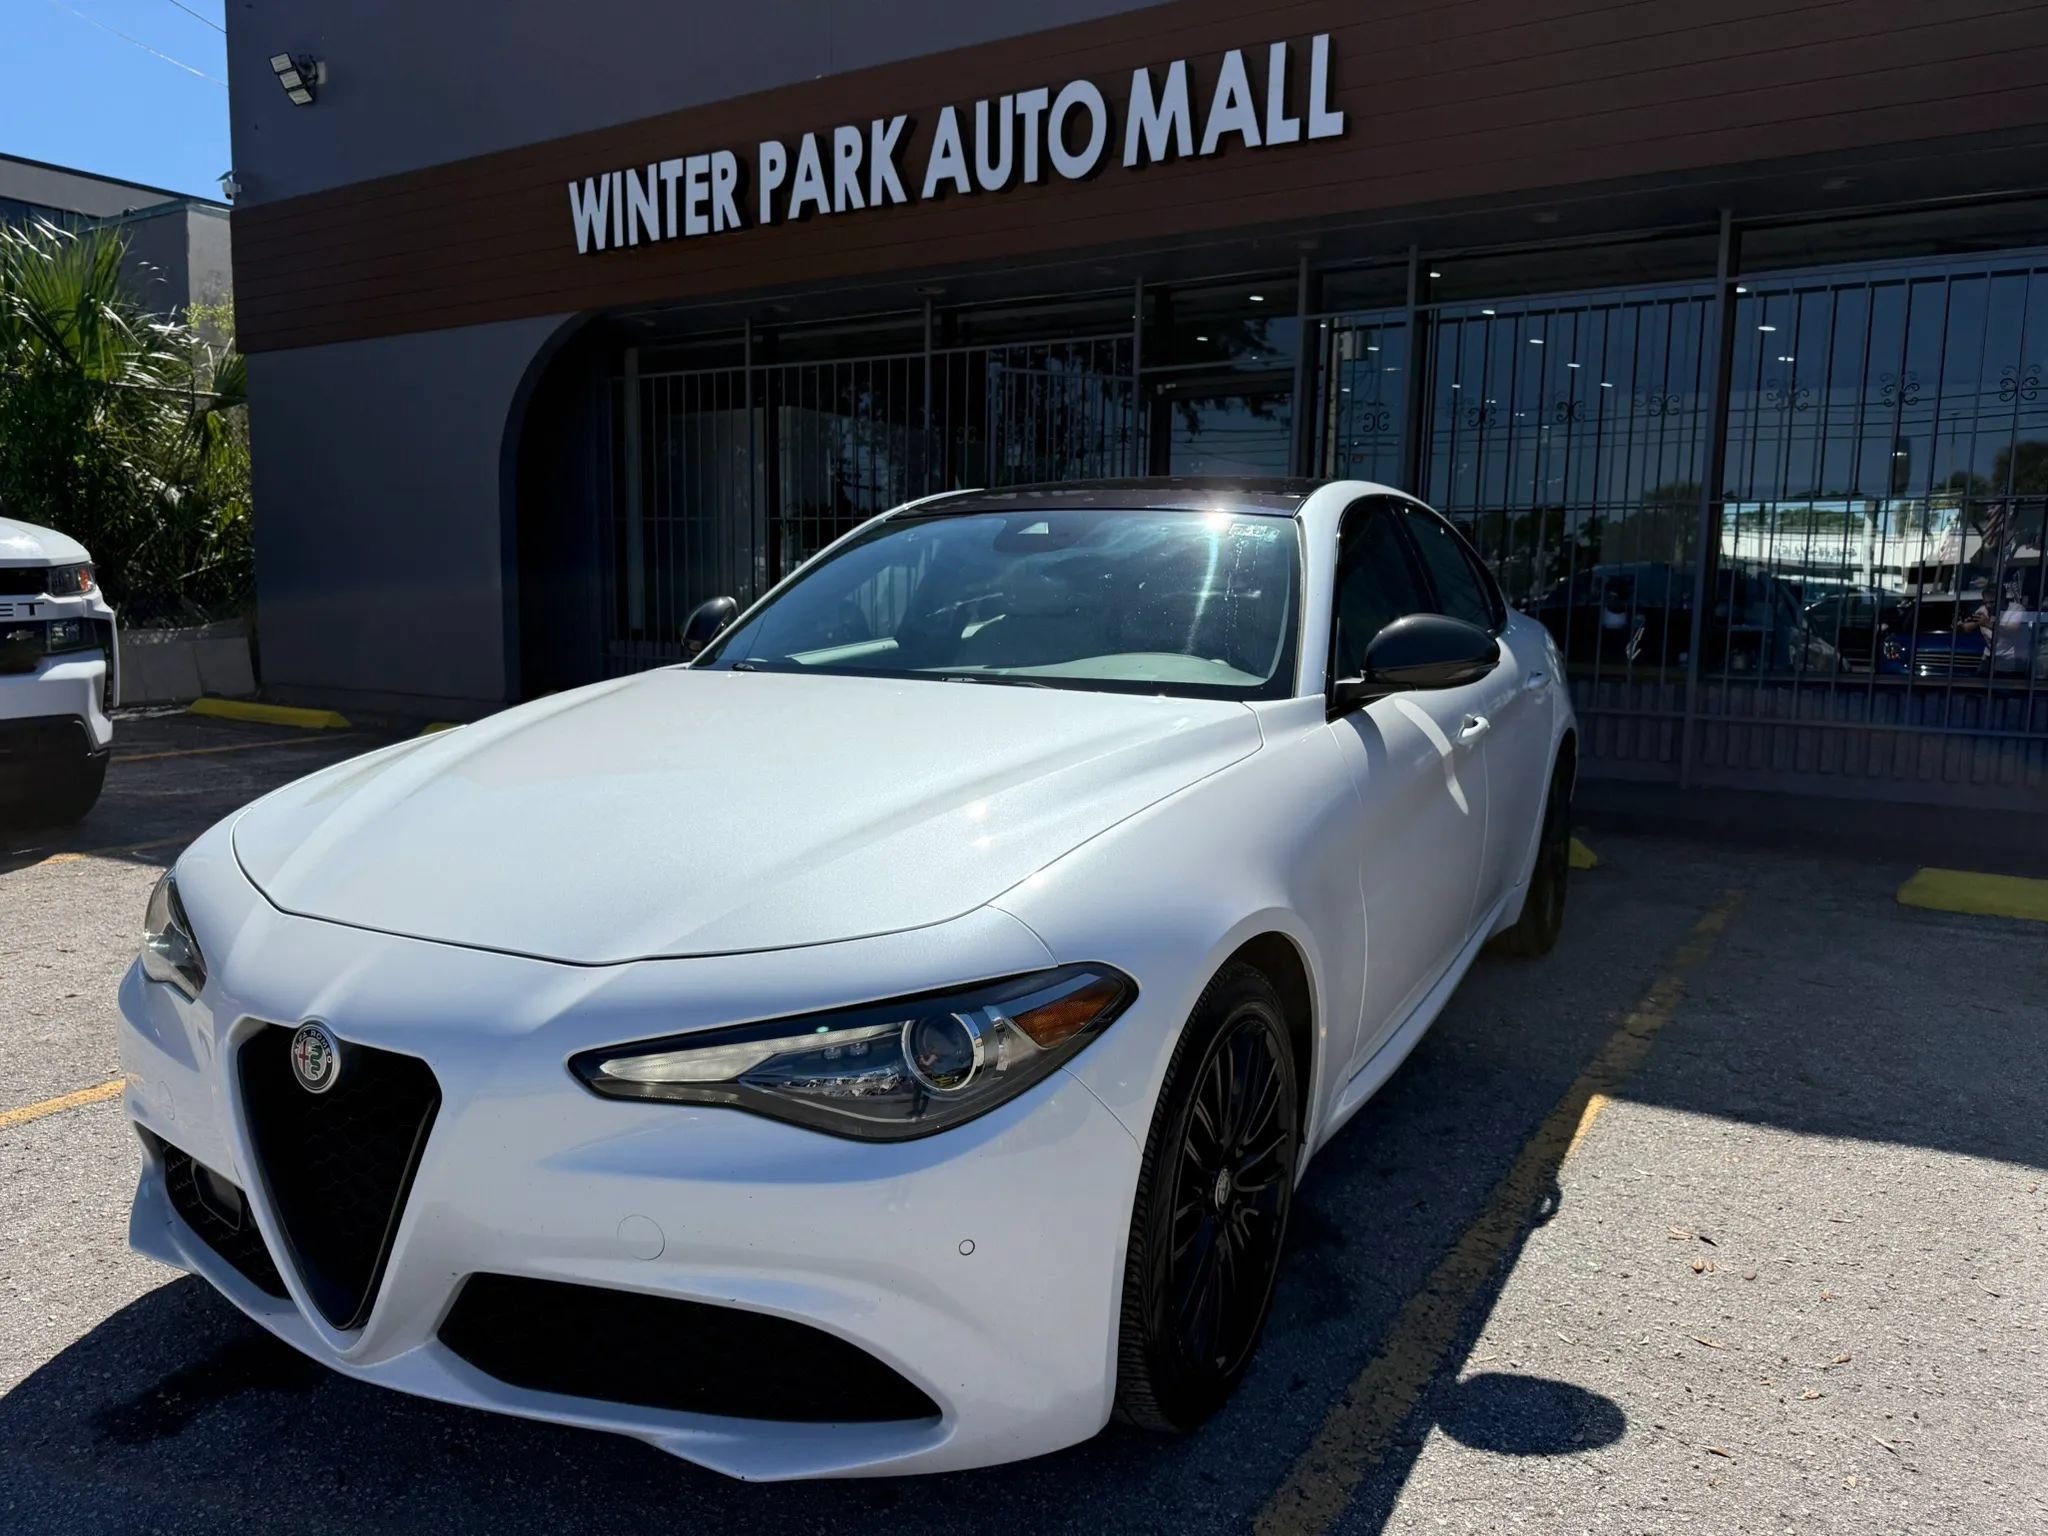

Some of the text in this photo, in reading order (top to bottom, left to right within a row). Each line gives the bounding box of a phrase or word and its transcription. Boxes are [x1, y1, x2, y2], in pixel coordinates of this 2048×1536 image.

[569, 33, 1344, 254] WINTER PARK AUTO MALL
[310, 1030, 332, 1064] ROMEO
